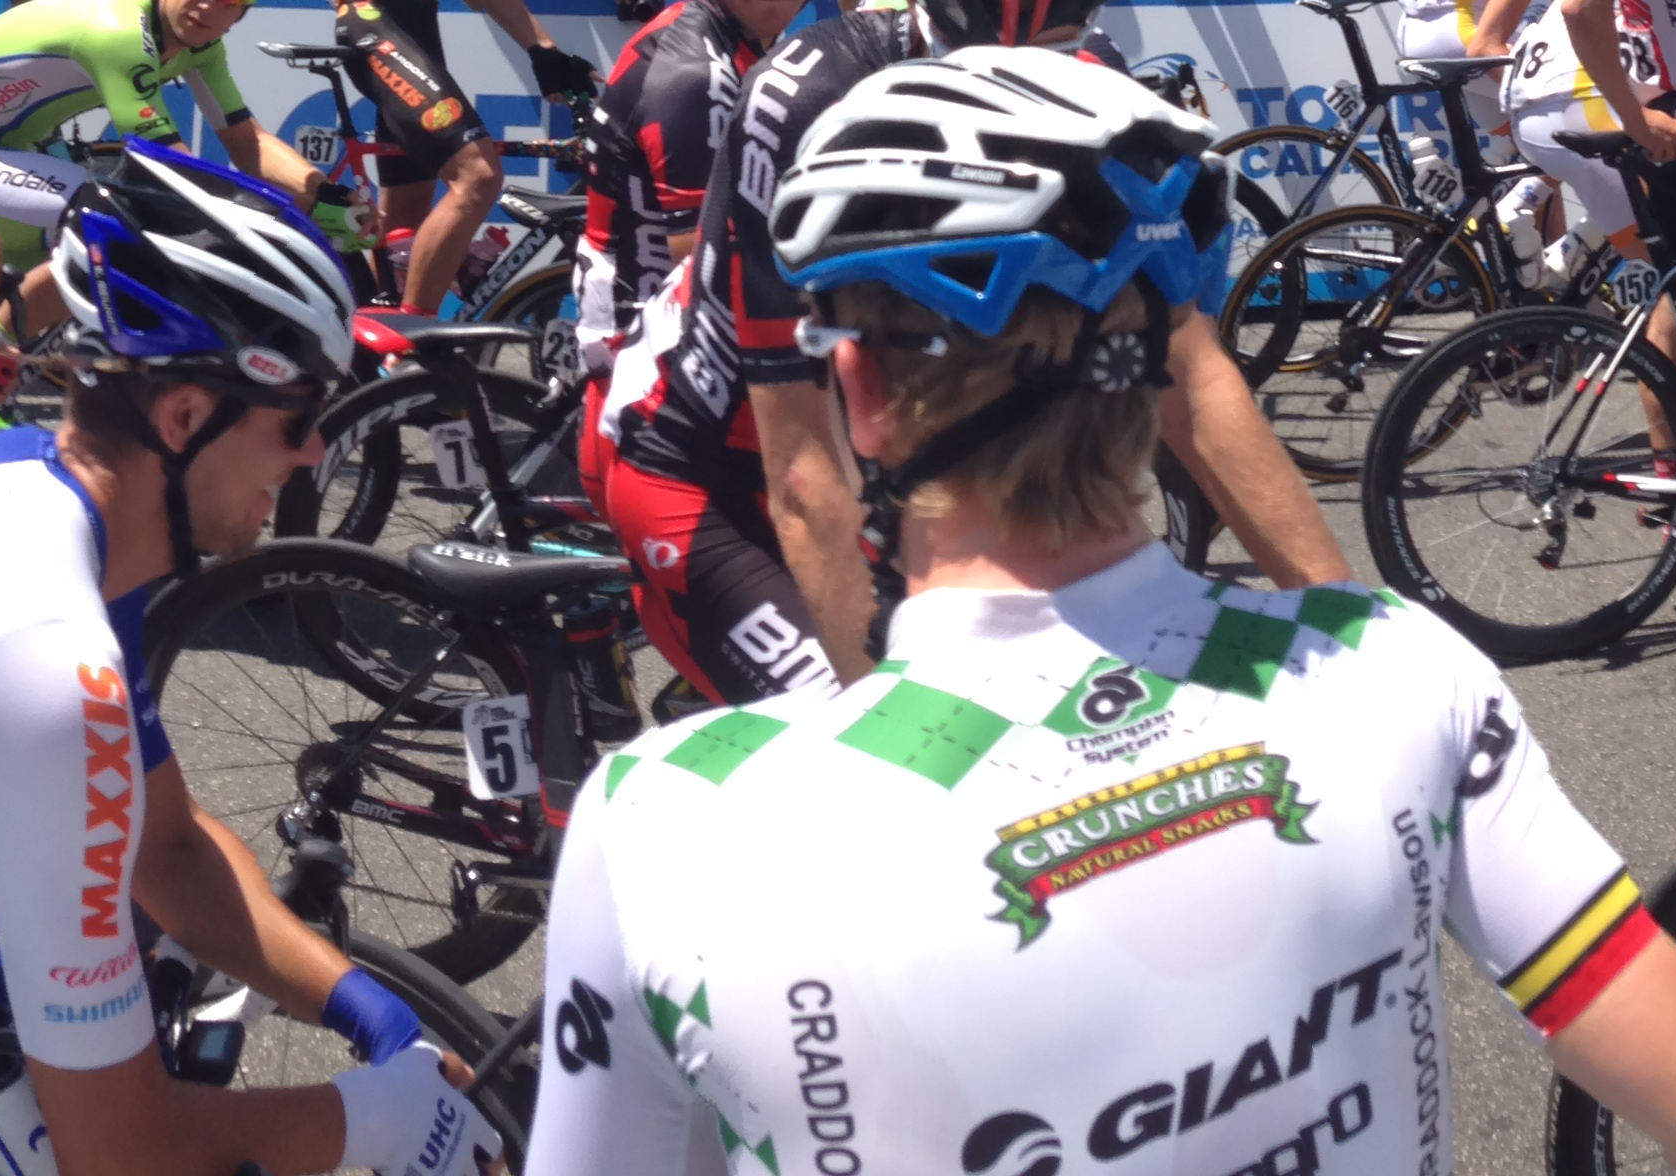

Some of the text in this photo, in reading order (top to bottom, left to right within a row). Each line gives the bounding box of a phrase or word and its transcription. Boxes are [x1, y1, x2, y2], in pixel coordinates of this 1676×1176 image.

[737, 37, 823, 215] BMC
[1328, 85, 1358, 119] 116
[299, 133, 334, 163] 137
[951, 165, 1005, 184] Lawson
[248, 351, 294, 381] BELL
[78, 661, 128, 940] MAXXIS
[352, 797, 405, 824] BMC
[1012, 762, 1266, 868] CRUNCHES
[1163, 804, 1252, 842] SNACKS
[1048, 836, 1157, 889] NATURAL
[1390, 809, 1435, 963] Lawson
[1086, 949, 1403, 1162] GIANT
[418, 1097, 458, 1171] UHC
